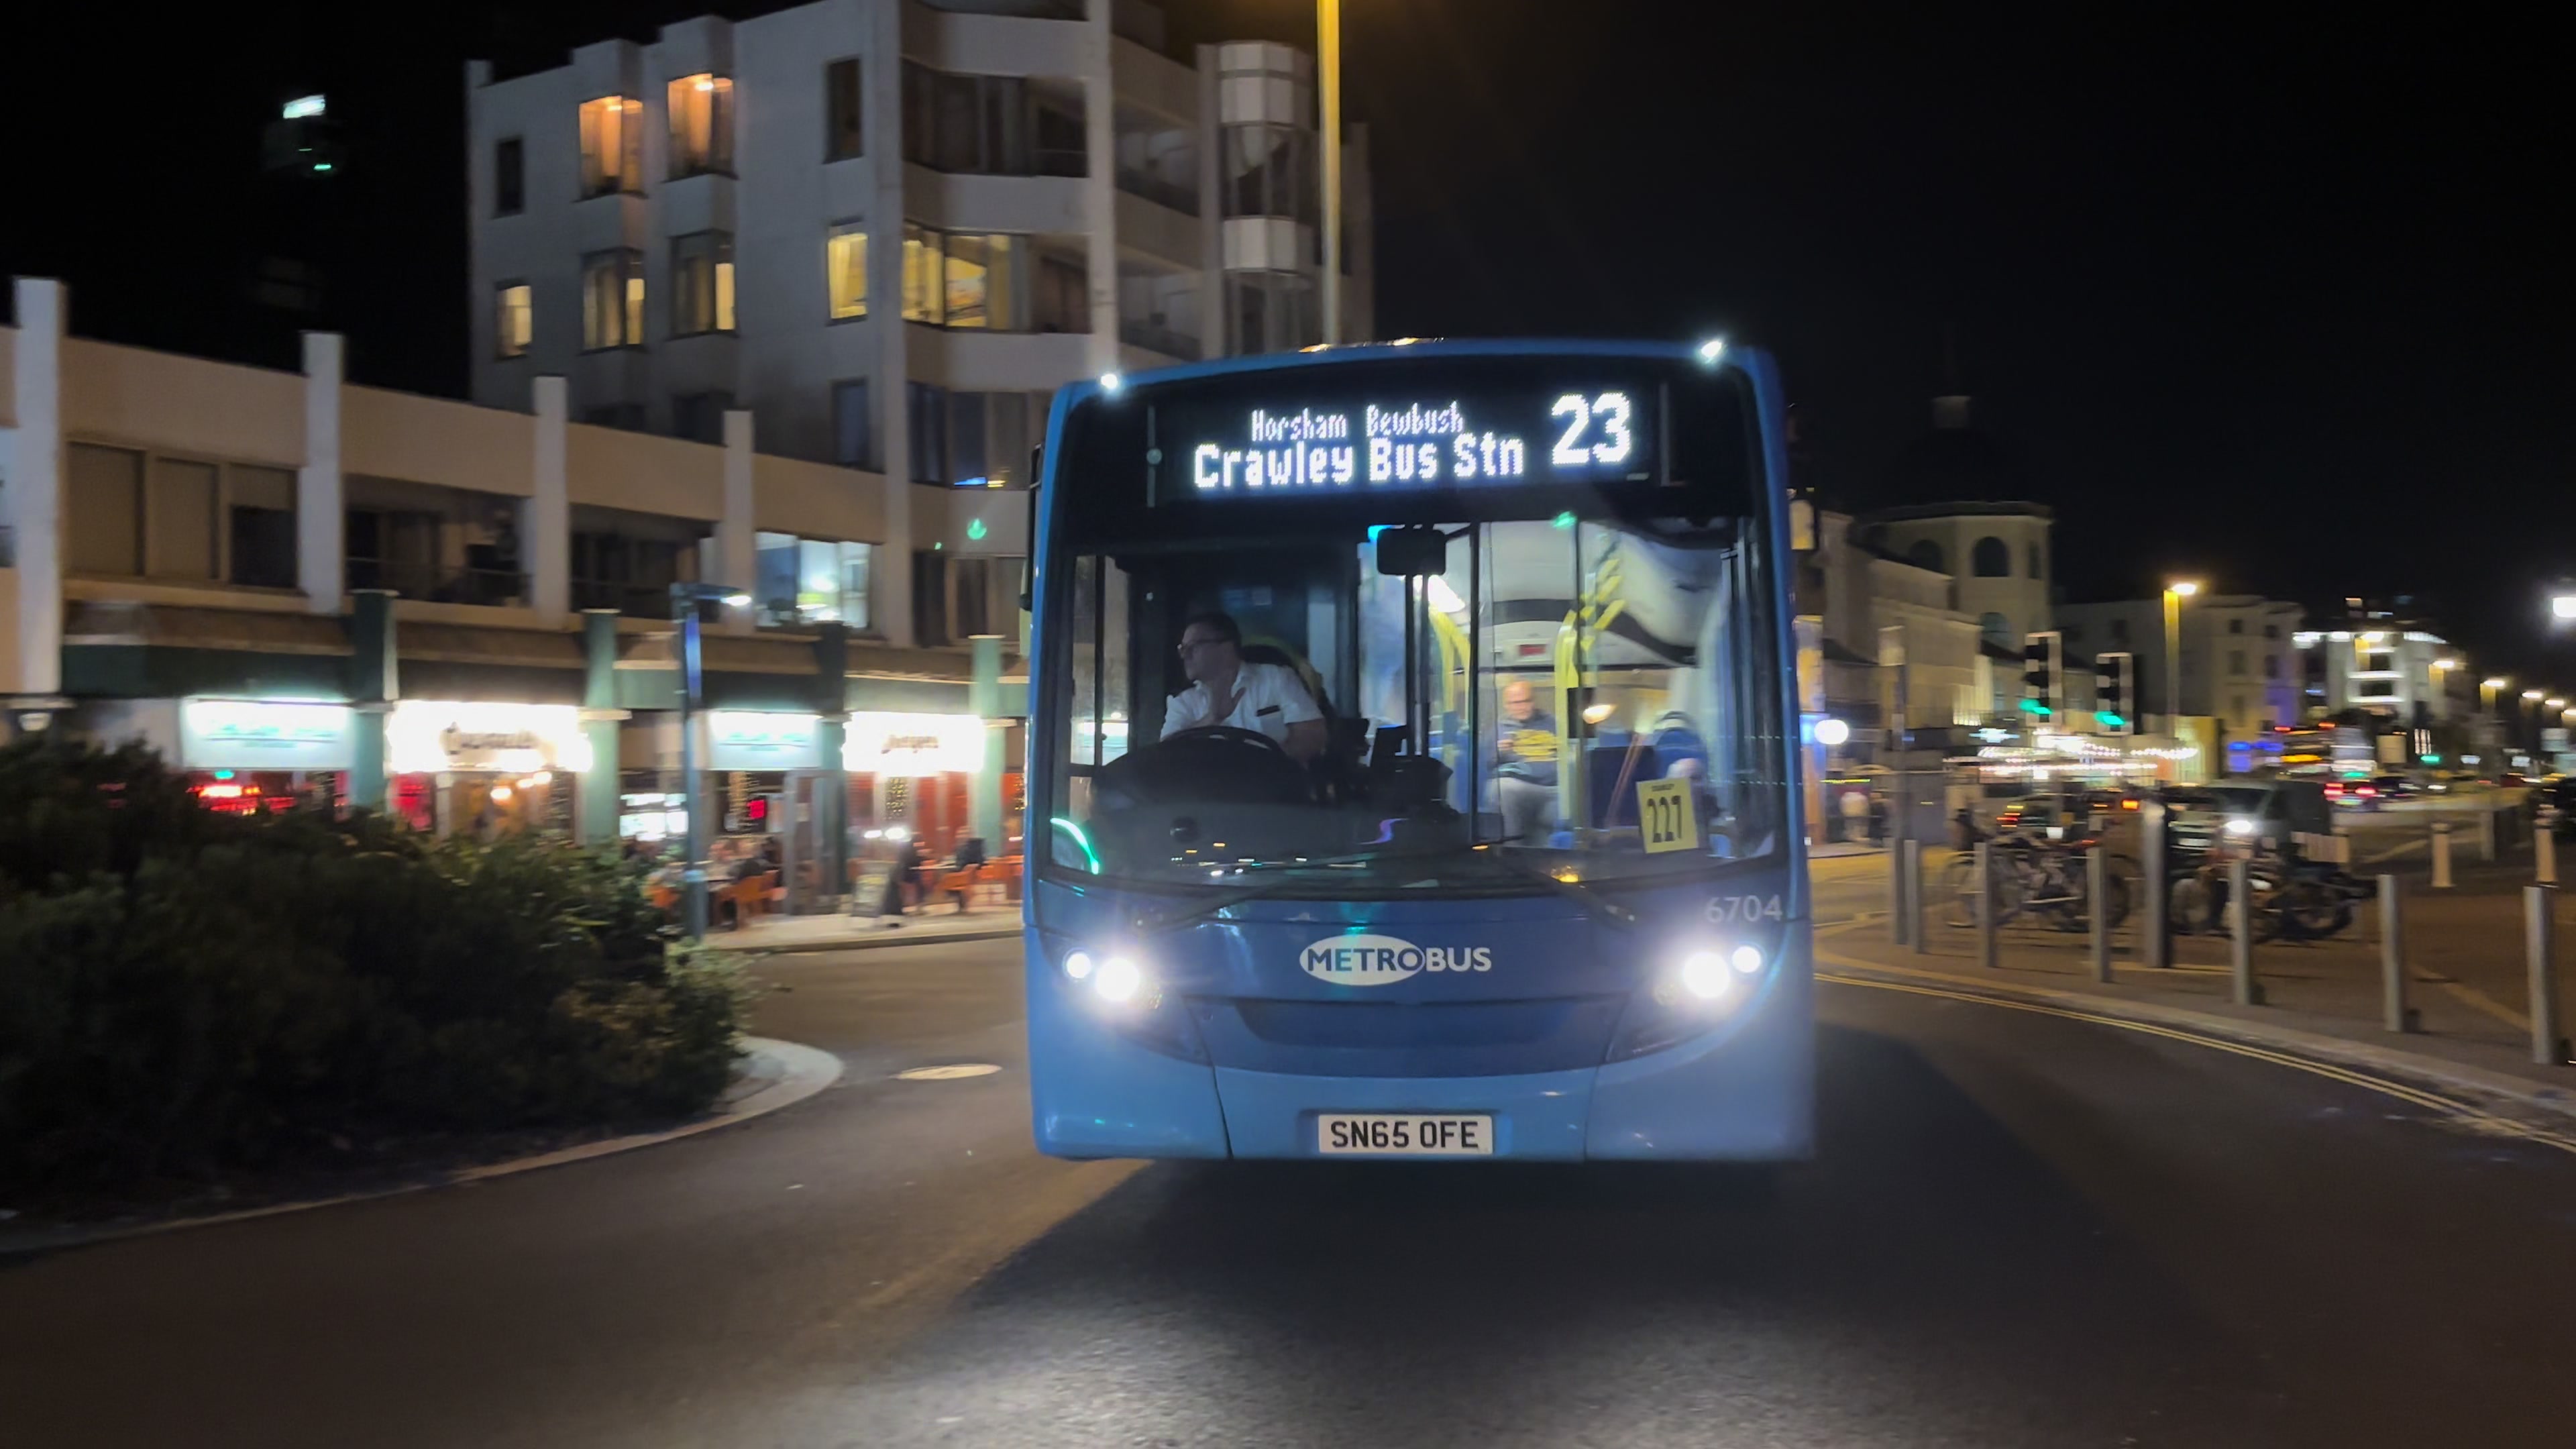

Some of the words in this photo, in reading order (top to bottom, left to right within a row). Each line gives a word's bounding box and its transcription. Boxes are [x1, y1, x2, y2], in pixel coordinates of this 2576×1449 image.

[1251, 407, 1347, 441] Horsham
[1366, 401, 1463, 435] Bewbush
[1551, 392, 1631, 466] 23
[1194, 440, 1352, 488] Crawley
[1369, 437, 1438, 481] Bus
[1454, 431, 1523, 478] Stn
[1705, 894, 1783, 923] 6704
[1307, 947, 1492, 972] METROBUS
[1330, 1120, 1409, 1148] SN65
[1419, 1120, 1479, 1148] OFE
